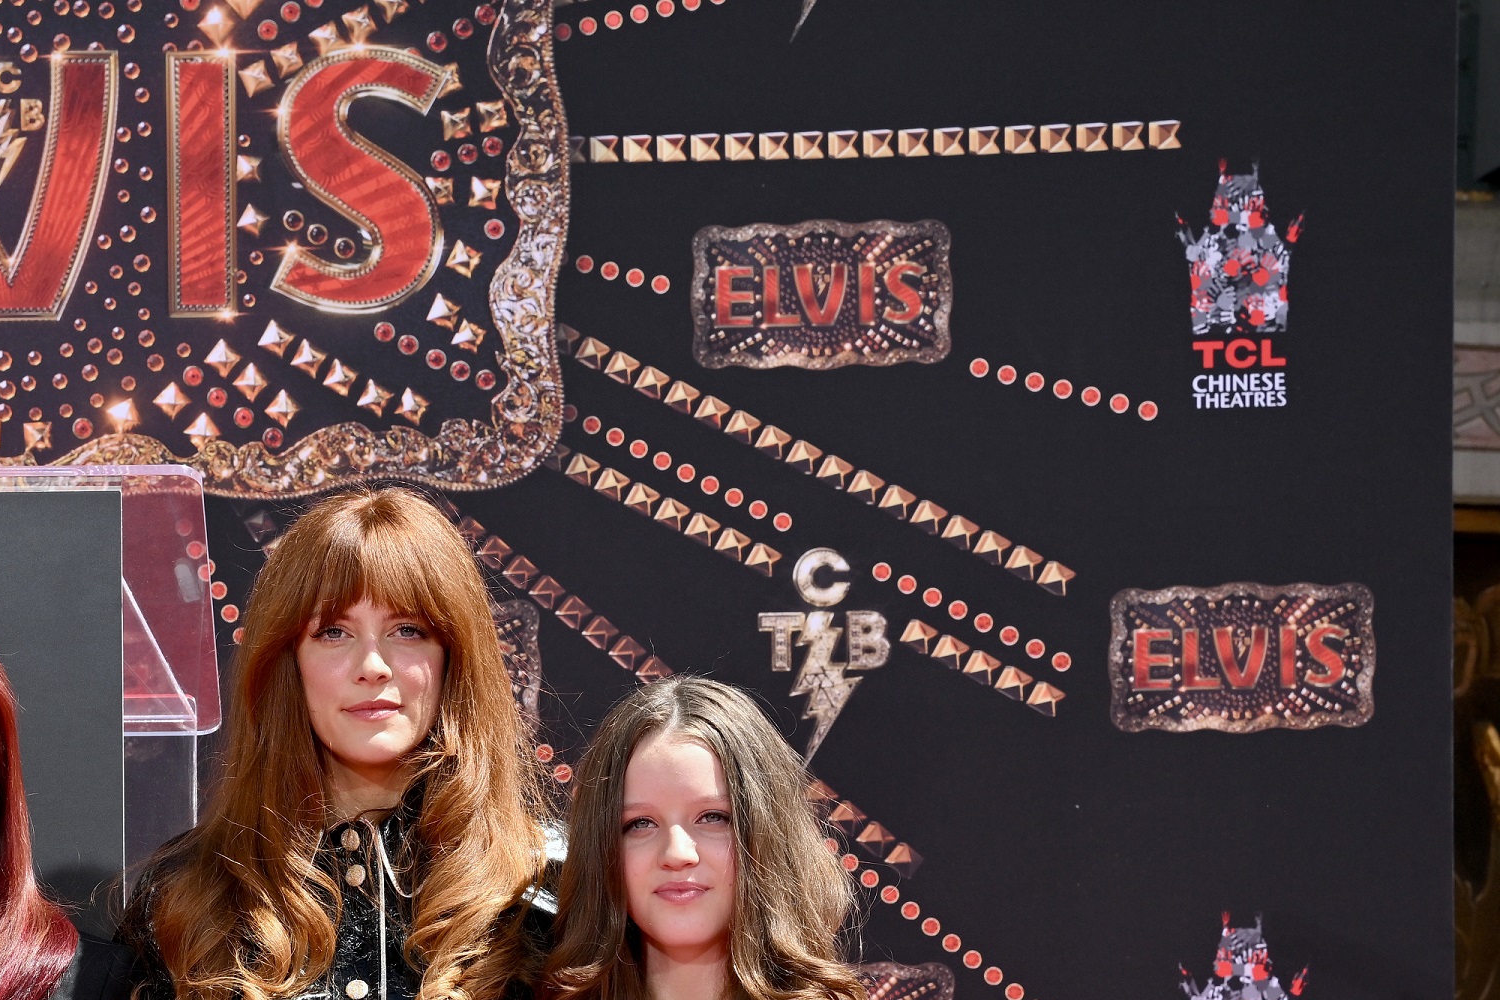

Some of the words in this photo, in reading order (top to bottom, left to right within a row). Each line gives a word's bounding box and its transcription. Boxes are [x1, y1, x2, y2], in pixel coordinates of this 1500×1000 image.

[714, 261, 928, 328] ELVIS
[1192, 338, 1287, 369] TCL
[1192, 372, 1287, 392] CHINESE
[1192, 390, 1288, 409] THEATRES
[1132, 623, 1350, 692] ELVIS
